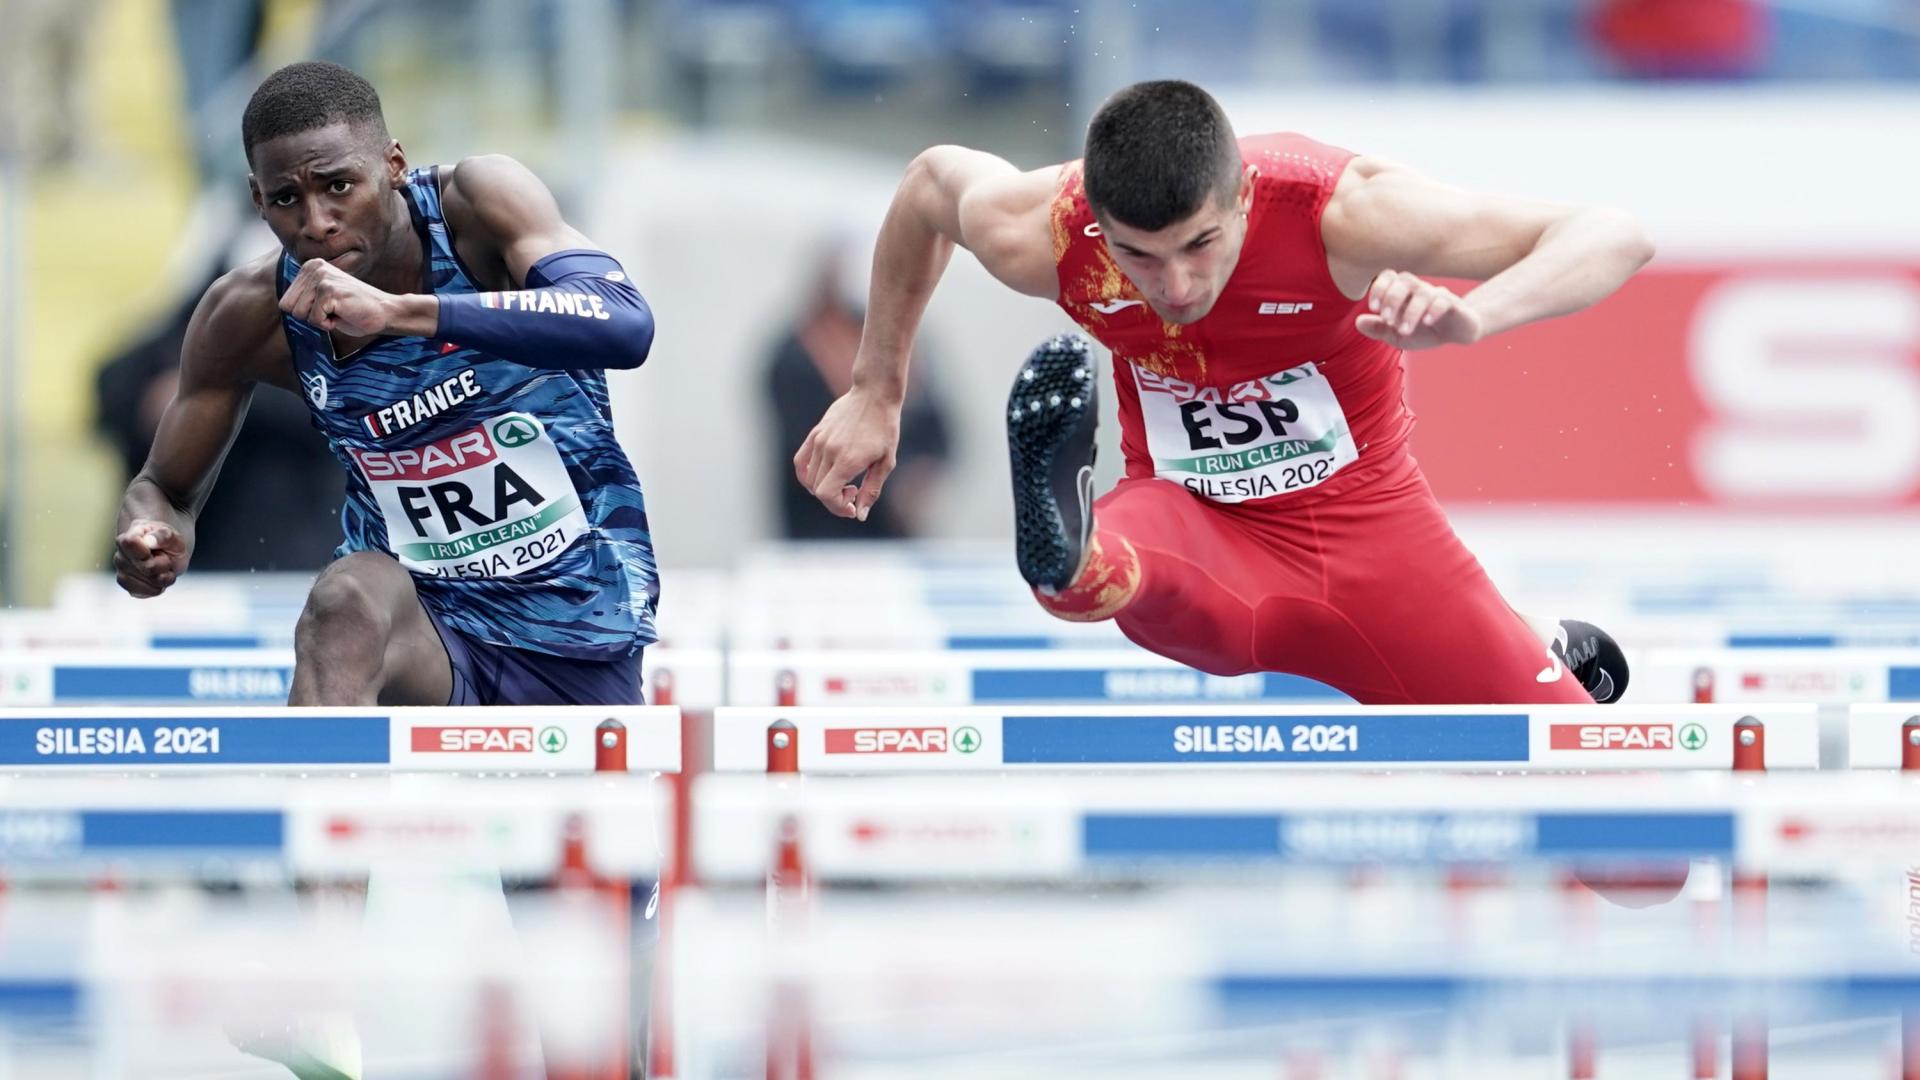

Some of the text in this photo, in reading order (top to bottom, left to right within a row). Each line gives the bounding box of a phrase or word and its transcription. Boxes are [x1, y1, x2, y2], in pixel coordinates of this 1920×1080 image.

[502, 290, 610, 320] FRANCE
[1258, 302, 1313, 315] ESP
[381, 368, 482, 435] FRANCE
[1179, 398, 1299, 451] ESP
[361, 430, 491, 479] SPAR
[1195, 462, 1201, 473] I
[1206, 456, 1244, 473] RUN
[1184, 475, 1278, 497] SILESIA
[396, 462, 546, 538] FRA
[428, 528, 567, 578] LESIA 2021
[430, 545, 436, 558] I
[437, 537, 475, 557] RUN
[36, 727, 220, 754] SILESIA 2021
[439, 729, 533, 751] SPAR
[854, 729, 947, 752] SPAR
[1173, 725, 1358, 752] SILESIA 2021
[1579, 726, 1673, 748] SPAR
